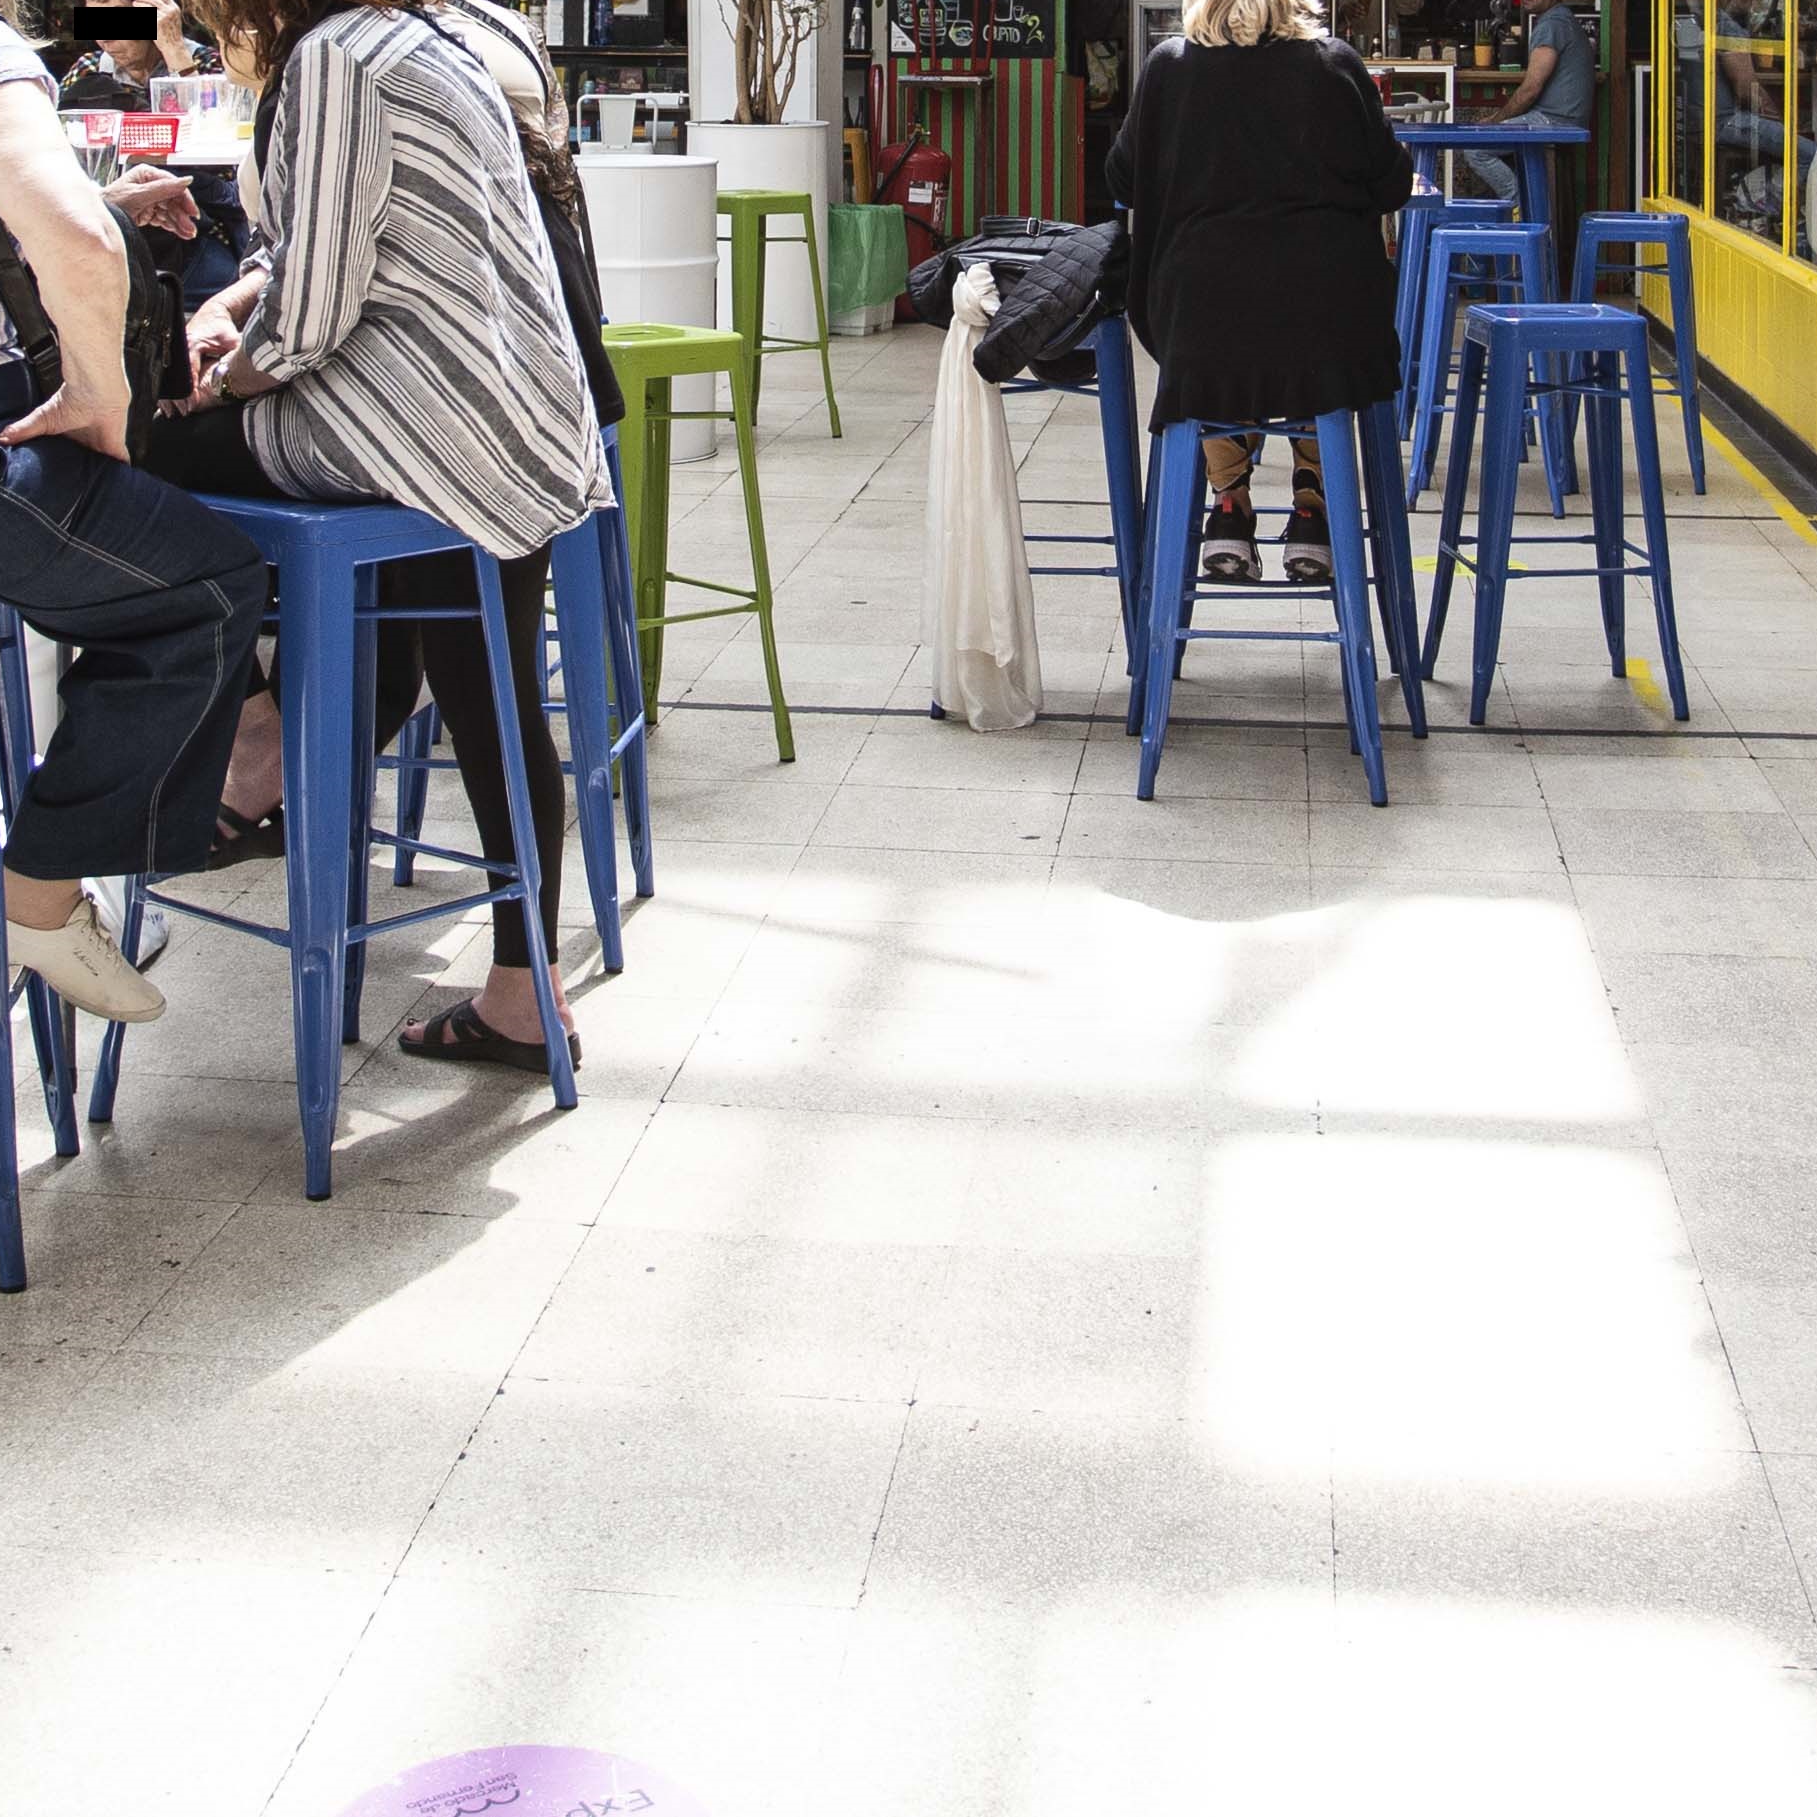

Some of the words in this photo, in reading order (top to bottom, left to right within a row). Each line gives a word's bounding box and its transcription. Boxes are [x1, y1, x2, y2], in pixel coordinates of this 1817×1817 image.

[443, 1779, 519, 1806] Mercado
[486, 1772, 519, 1787] San
[405, 1782, 485, 1809] Fernando
